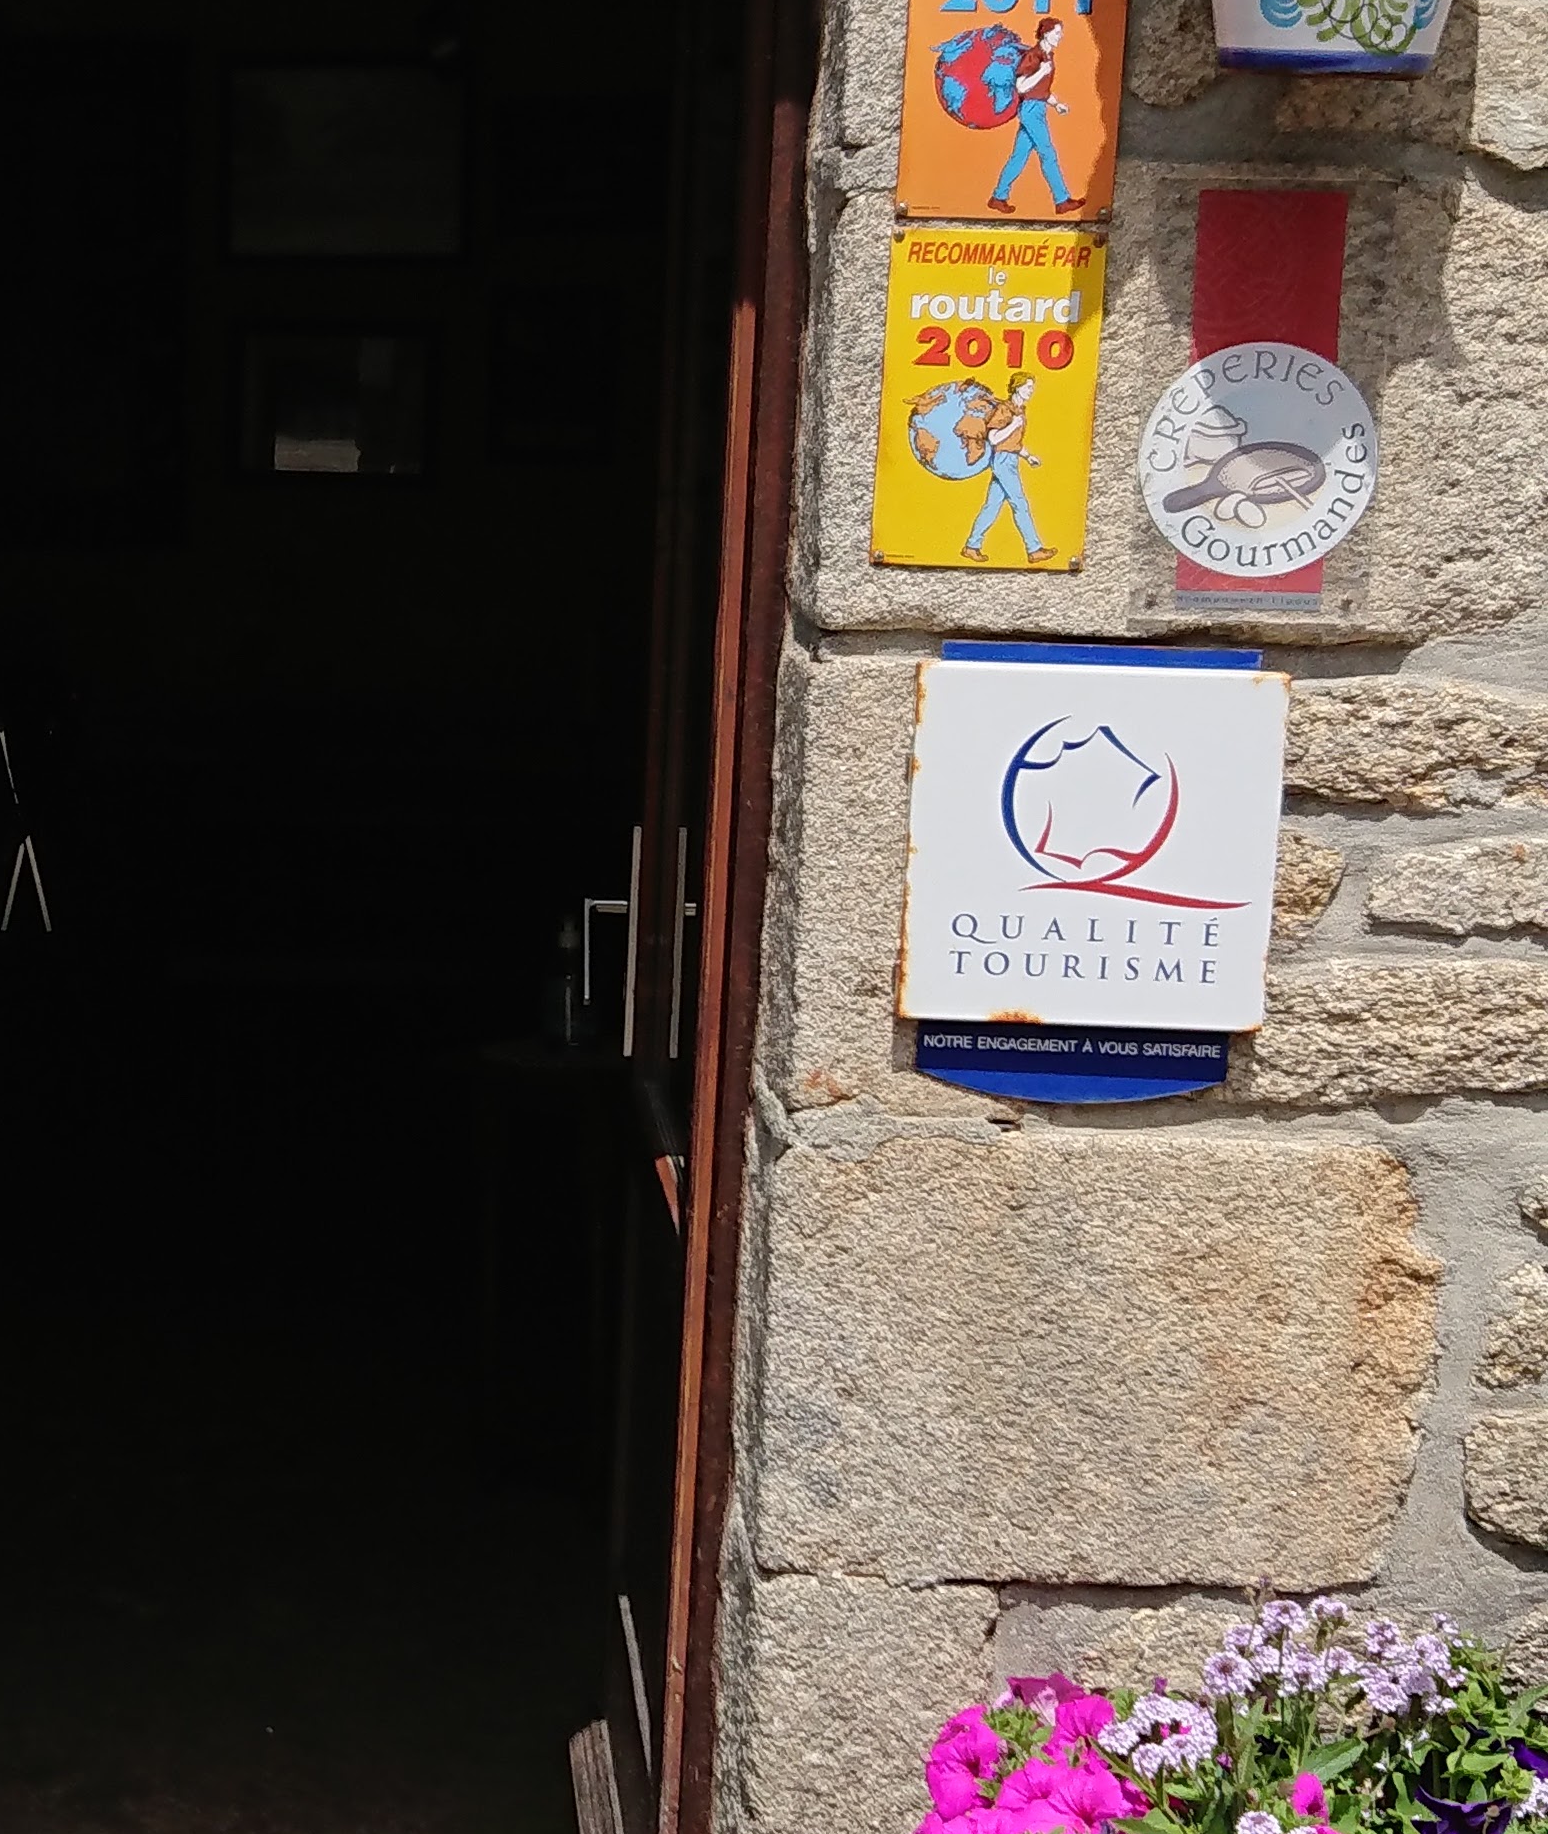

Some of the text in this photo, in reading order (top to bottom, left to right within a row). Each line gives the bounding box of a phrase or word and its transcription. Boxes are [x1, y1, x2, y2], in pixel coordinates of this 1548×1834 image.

[908, 238, 1091, 268] RECOMMANDÉ PAR
[988, 266, 1007, 285] le
[911, 288, 1081, 323] routard
[912, 326, 1074, 370] 2010
[1181, 422, 1368, 567] Gourmandes
[951, 913, 1219, 947] QUALITÉ
[949, 950, 1217, 984] TOURISME
[977, 1036, 1078, 1052] ENGAGEMENT
[1098, 1040, 1139, 1055] VOUS
[1142, 1042, 1222, 1058] SATISFAIRE
